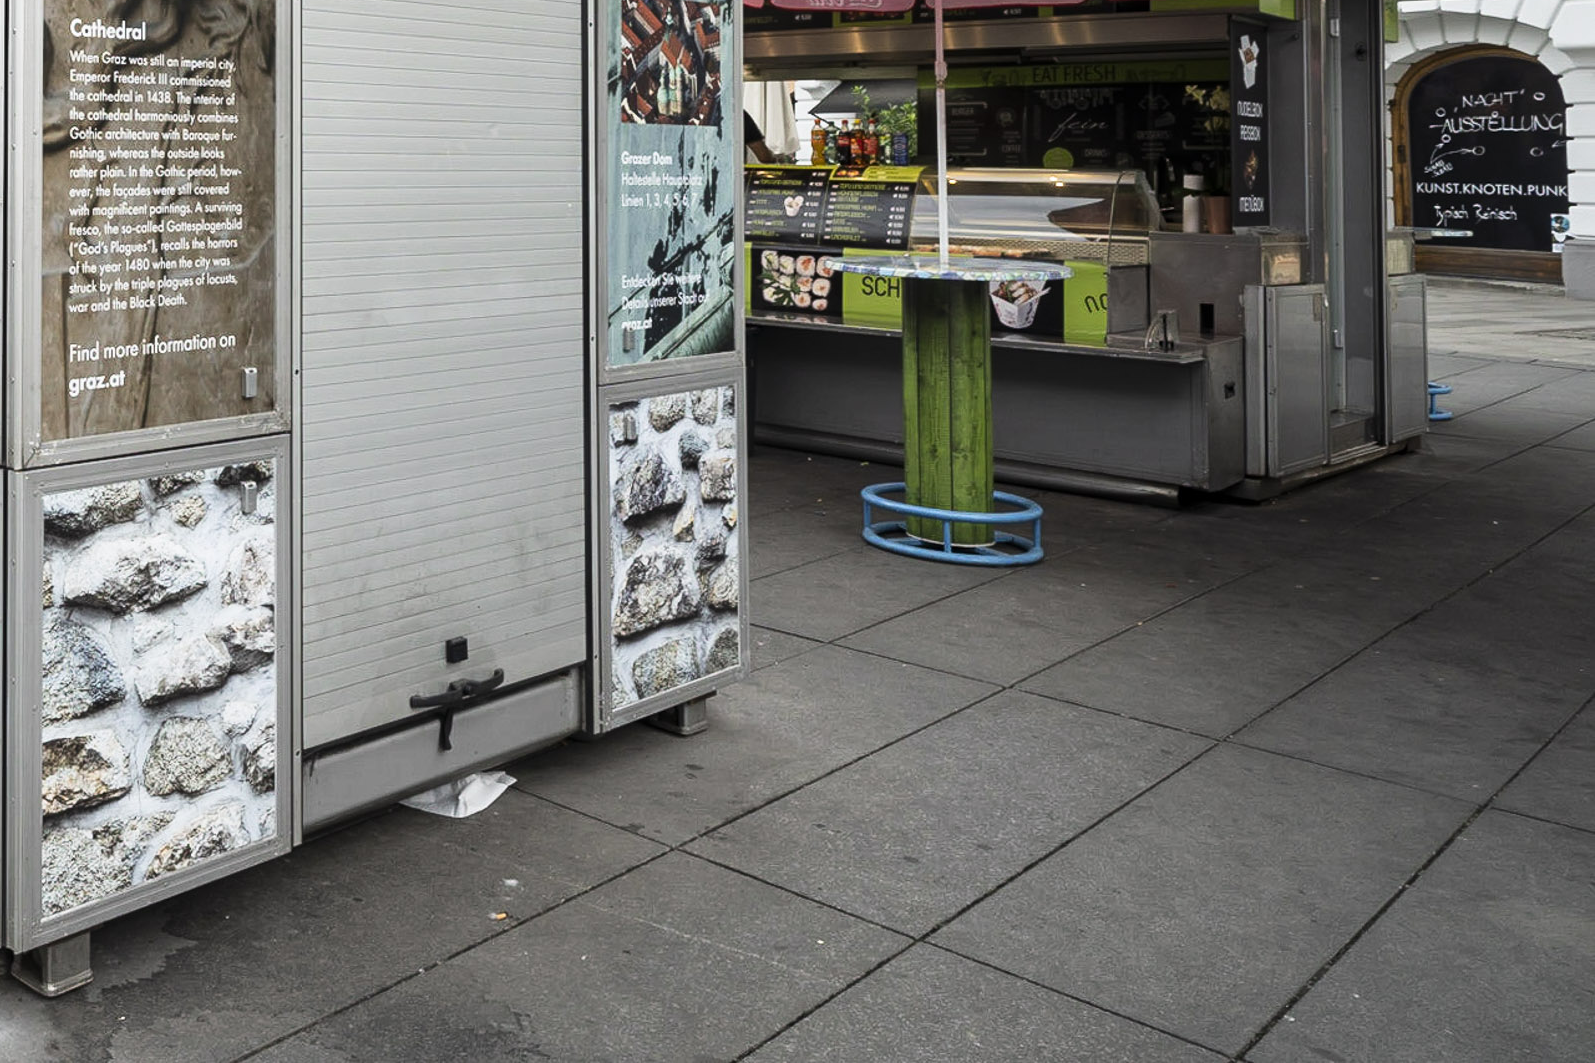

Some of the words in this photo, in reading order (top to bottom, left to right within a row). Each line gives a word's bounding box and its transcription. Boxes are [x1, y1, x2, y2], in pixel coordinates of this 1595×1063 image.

[70, 18, 146, 40] Cathedral
[70, 50, 99, 63] When
[102, 51, 126, 64] Graz
[129, 57, 148, 66] was
[150, 54, 164, 66] still
[166, 58, 179, 67] an
[181, 57, 216, 72] imperial
[218, 59, 236, 73] city,
[70, 69, 110, 83] Emperor
[114, 71, 156, 85] Frederick
[159, 73, 167, 85] III
[170, 76, 231, 87] commissioned
[1032, 66, 1060, 83] EAT
[1063, 65, 1115, 82] FRESH
[70, 88, 84, 100] the
[87, 89, 132, 102] cathedral
[135, 92, 143, 102] in
[147, 92, 173, 103] 1438.
[176, 92, 191, 104] The
[194, 93, 223, 105] interior
[226, 93, 235, 105] of
[70, 107, 84, 119] the
[87, 108, 132, 121] cathedral
[135, 109, 194, 125] harmoniously
[197, 112, 238, 123] combines
[70, 126, 102, 139] Gothic
[105, 128, 159, 140] architecture
[161, 129, 180, 140] with
[183, 129, 220, 142] Baroque
[222, 130, 237, 140] fur-
[70, 147, 106, 161] nishing,
[109, 148, 149, 159] whereas
[151, 147, 165, 159] the
[167, 147, 199, 159] outside
[201, 147, 225, 159] looks
[621, 151, 651, 165] Grazer
[653, 151, 672, 165] Dom
[70, 166, 97, 178] rather
[100, 165, 126, 179] plain.
[129, 167, 137, 177] In
[140, 165, 153, 177] the
[156, 165, 185, 177] Gothic
[188, 165, 218, 179] period,
[220, 165, 241, 176] how-
[622, 172, 661, 185] Haltestelle
[663, 173, 702, 186] Hauptplatz
[69, 186, 93, 198] ever,
[96, 184, 110, 196] the
[114, 184, 150, 200] façades
[153, 187, 175, 196] were
[178, 183, 191, 195] still
[194, 182, 229, 195] covered
[621, 194, 643, 206] Linien
[692, 193, 697, 206] 7
[69, 203, 89, 216] with
[92, 202, 147, 219] magnificent
[150, 203, 192, 217] paintings.
[195, 202, 202, 212] A
[205, 202, 242, 214] surviving
[69, 222, 101, 236] fresco,
[104, 222, 119, 234] the
[122, 221, 164, 234] so-called
[167, 218, 242, 233] Gottesplagenbild
[161, 238, 190, 251] recalls
[192, 237, 205, 249] the
[207, 237, 237, 249] horrors
[69, 261, 80, 274] of
[82, 261, 97, 273] the
[100, 263, 121, 275] year
[126, 259, 150, 271] 1480
[152, 257, 177, 269] when
[179, 256, 193, 268] the
[195, 256, 210, 269] city
[213, 258, 230, 266] was
[69, 280, 97, 294] struck
[100, 278, 112, 295] by
[115, 278, 129, 291] the
[132, 277, 155, 292] triple
[158, 277, 193, 290] plagues
[195, 273, 204, 286] of
[207, 274, 237, 286] locusts,
[622, 275, 660, 288] Entdecken
[662, 272, 674, 285] Sie
[69, 302, 88, 313] war
[91, 298, 110, 312] and
[113, 297, 127, 310] the
[130, 296, 155, 309] Black
[158, 294, 187, 306] Death.
[622, 296, 648, 309] Details
[678, 292, 697, 305] Stadt
[70, 340, 99, 363] Find
[104, 344, 139, 359] more
[143, 335, 216, 355] information
[220, 336, 235, 347] on
[69, 370, 125, 397] graz.at
